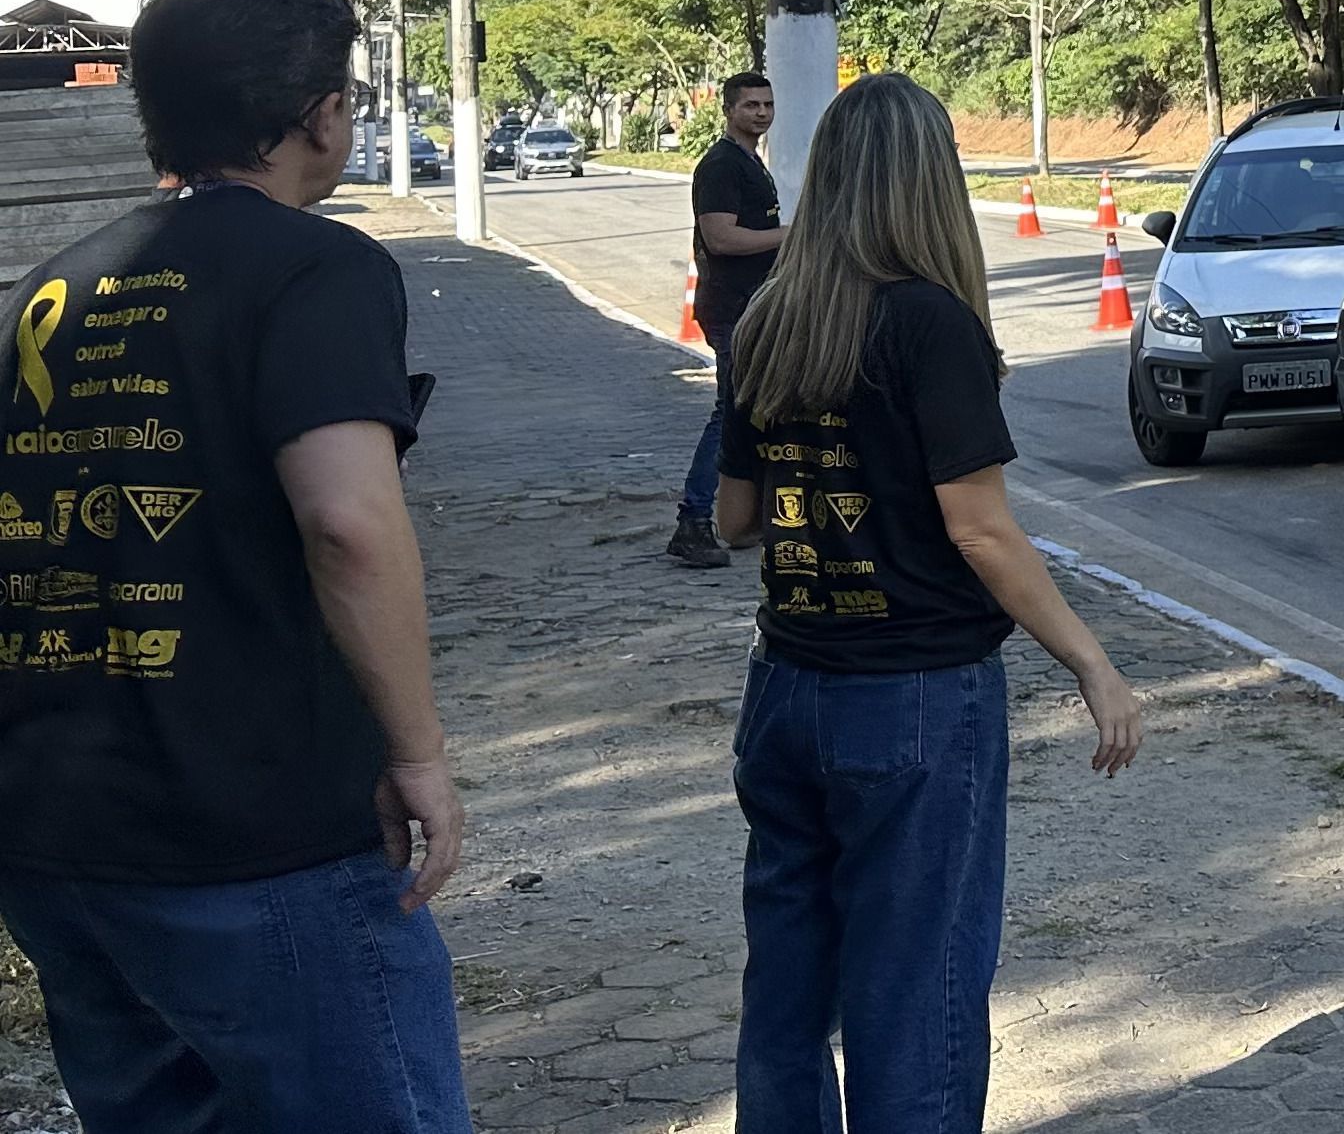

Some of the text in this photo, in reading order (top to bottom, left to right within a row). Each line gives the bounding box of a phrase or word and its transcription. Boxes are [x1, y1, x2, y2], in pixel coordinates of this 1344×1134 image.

[96, 277, 122, 295] No
[153, 306, 168, 322] o
[112, 373, 170, 395] vidas
[140, 493, 182, 507] DER
[837, 497, 864, 508] DER
[144, 505, 176, 518] MG
[842, 506, 862, 516] MG
